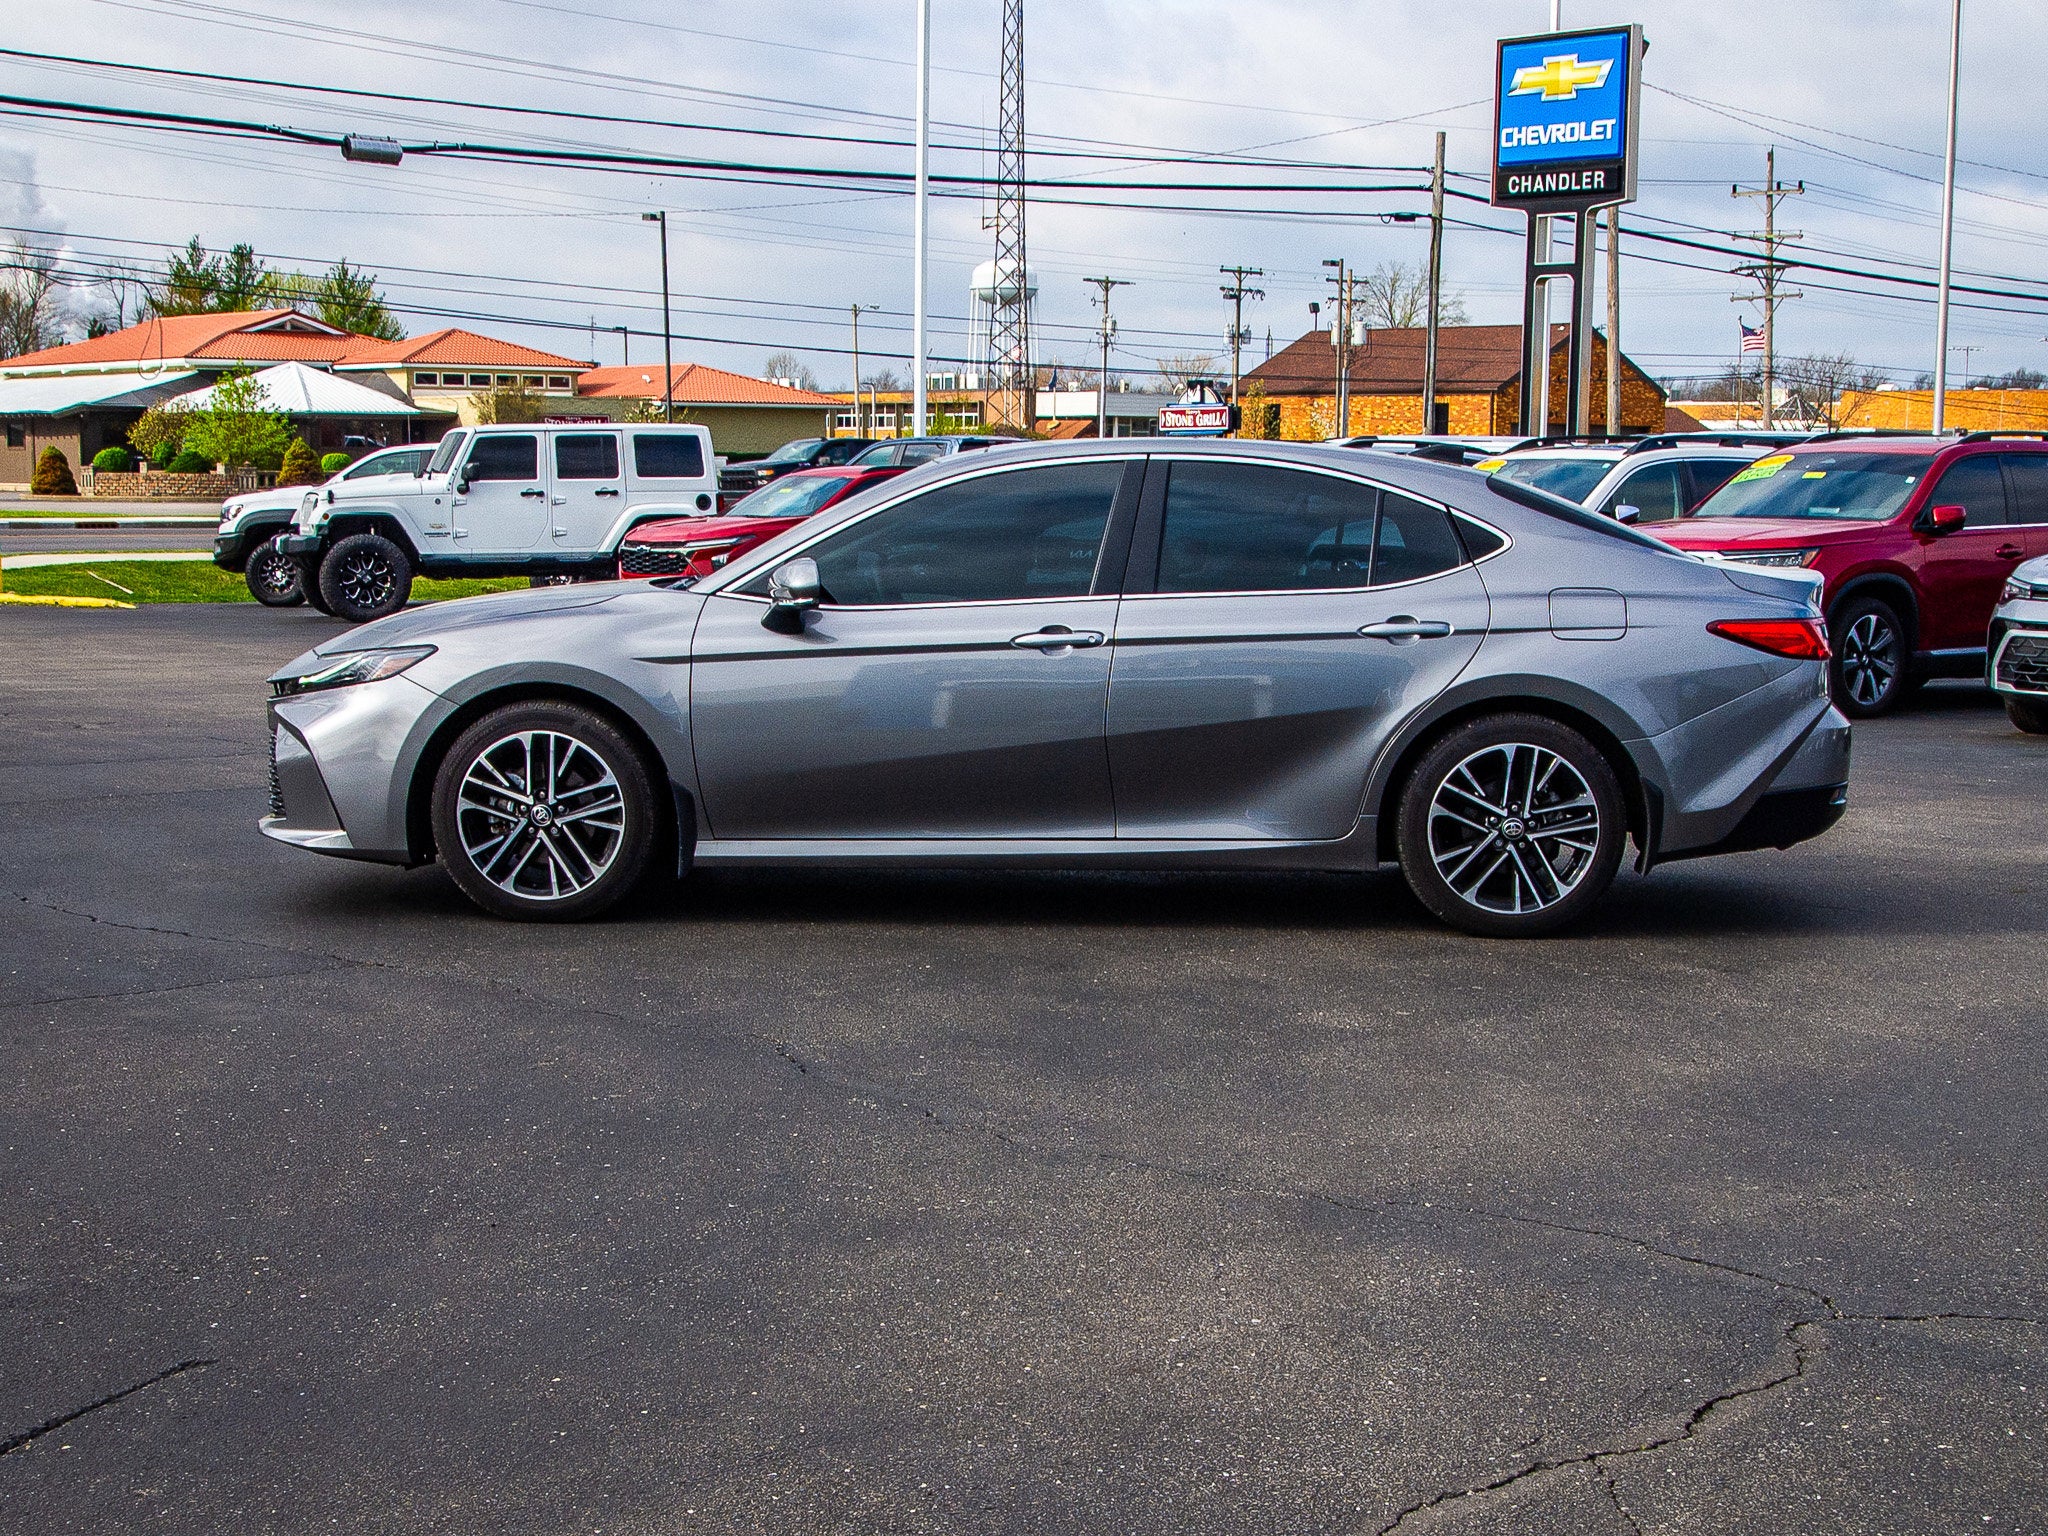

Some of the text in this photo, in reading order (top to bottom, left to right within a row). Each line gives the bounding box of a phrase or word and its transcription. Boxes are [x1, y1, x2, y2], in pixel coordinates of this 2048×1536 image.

[1501, 118, 1617, 148] CHEVROLET
[1508, 170, 1605, 194] CHANDLER
[1165, 411, 1222, 427] STONE GRILL
